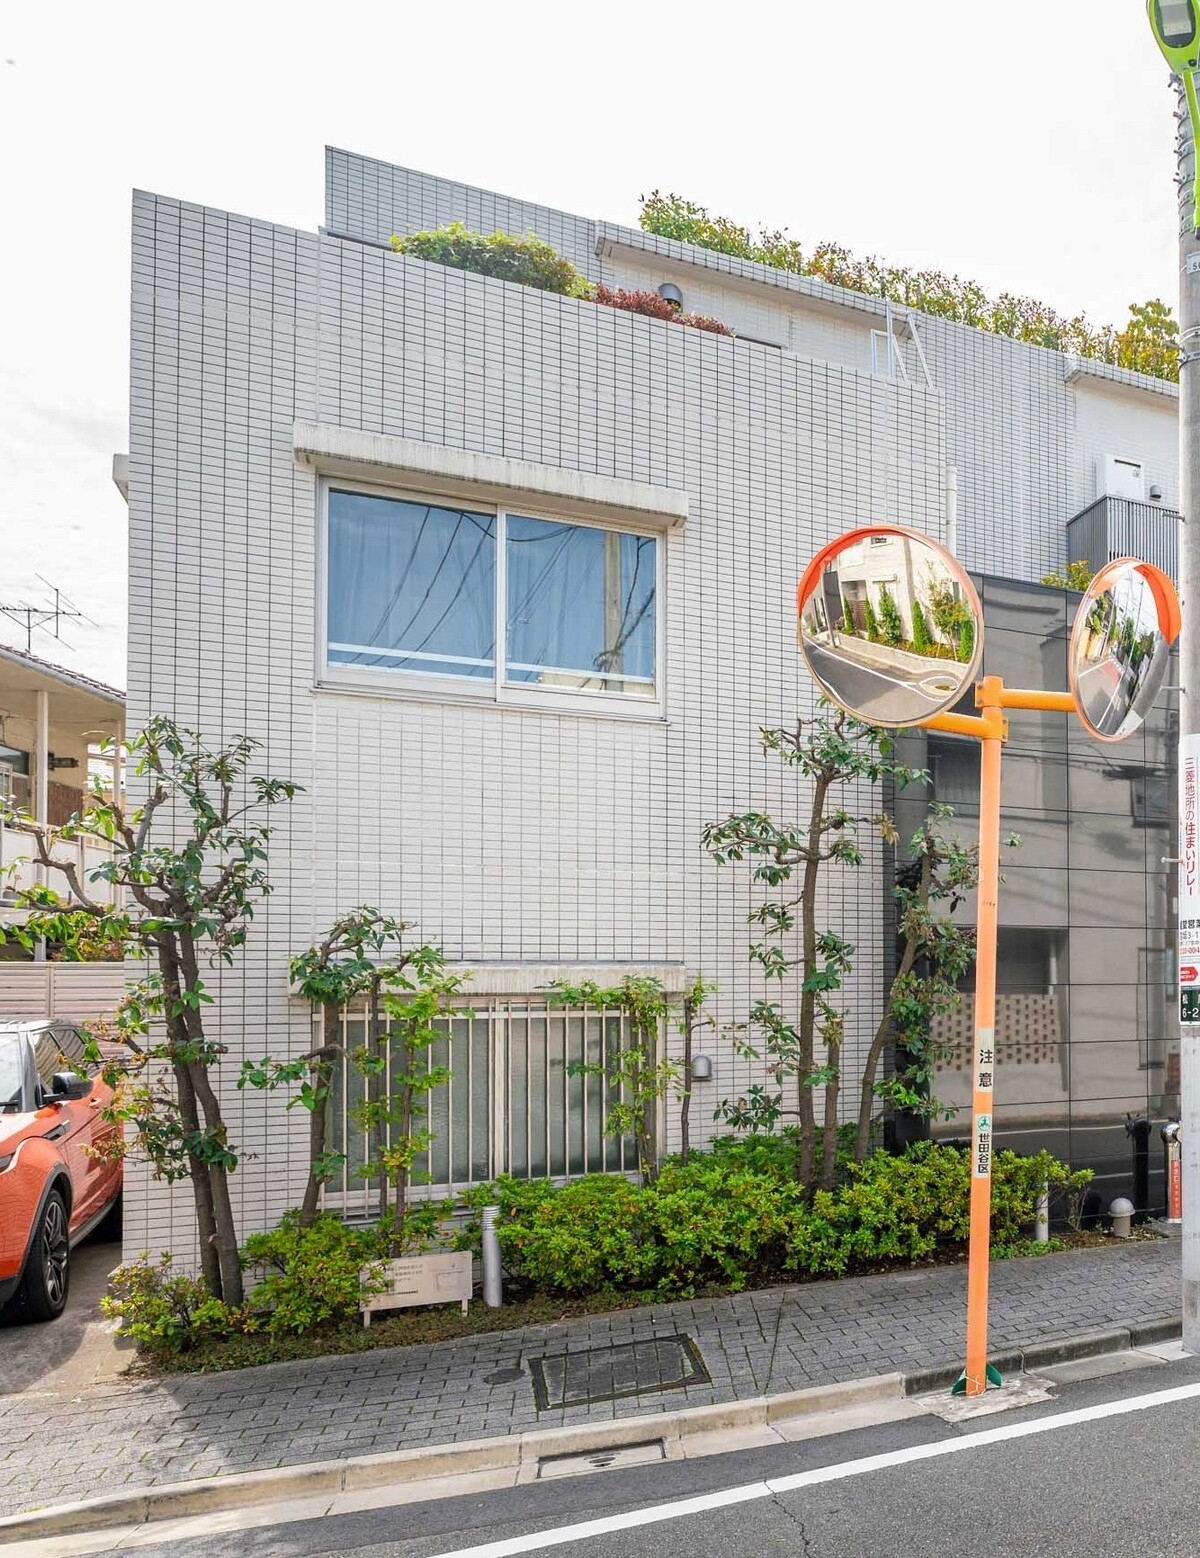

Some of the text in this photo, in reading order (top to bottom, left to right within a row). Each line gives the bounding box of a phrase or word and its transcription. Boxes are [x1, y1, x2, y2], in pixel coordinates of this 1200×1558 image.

[1185, 757, 1196, 895] 三菱地所の住まいリレー
[979, 1049, 994, 1087] 注意
[977, 1133, 990, 1173] 世田谷区
